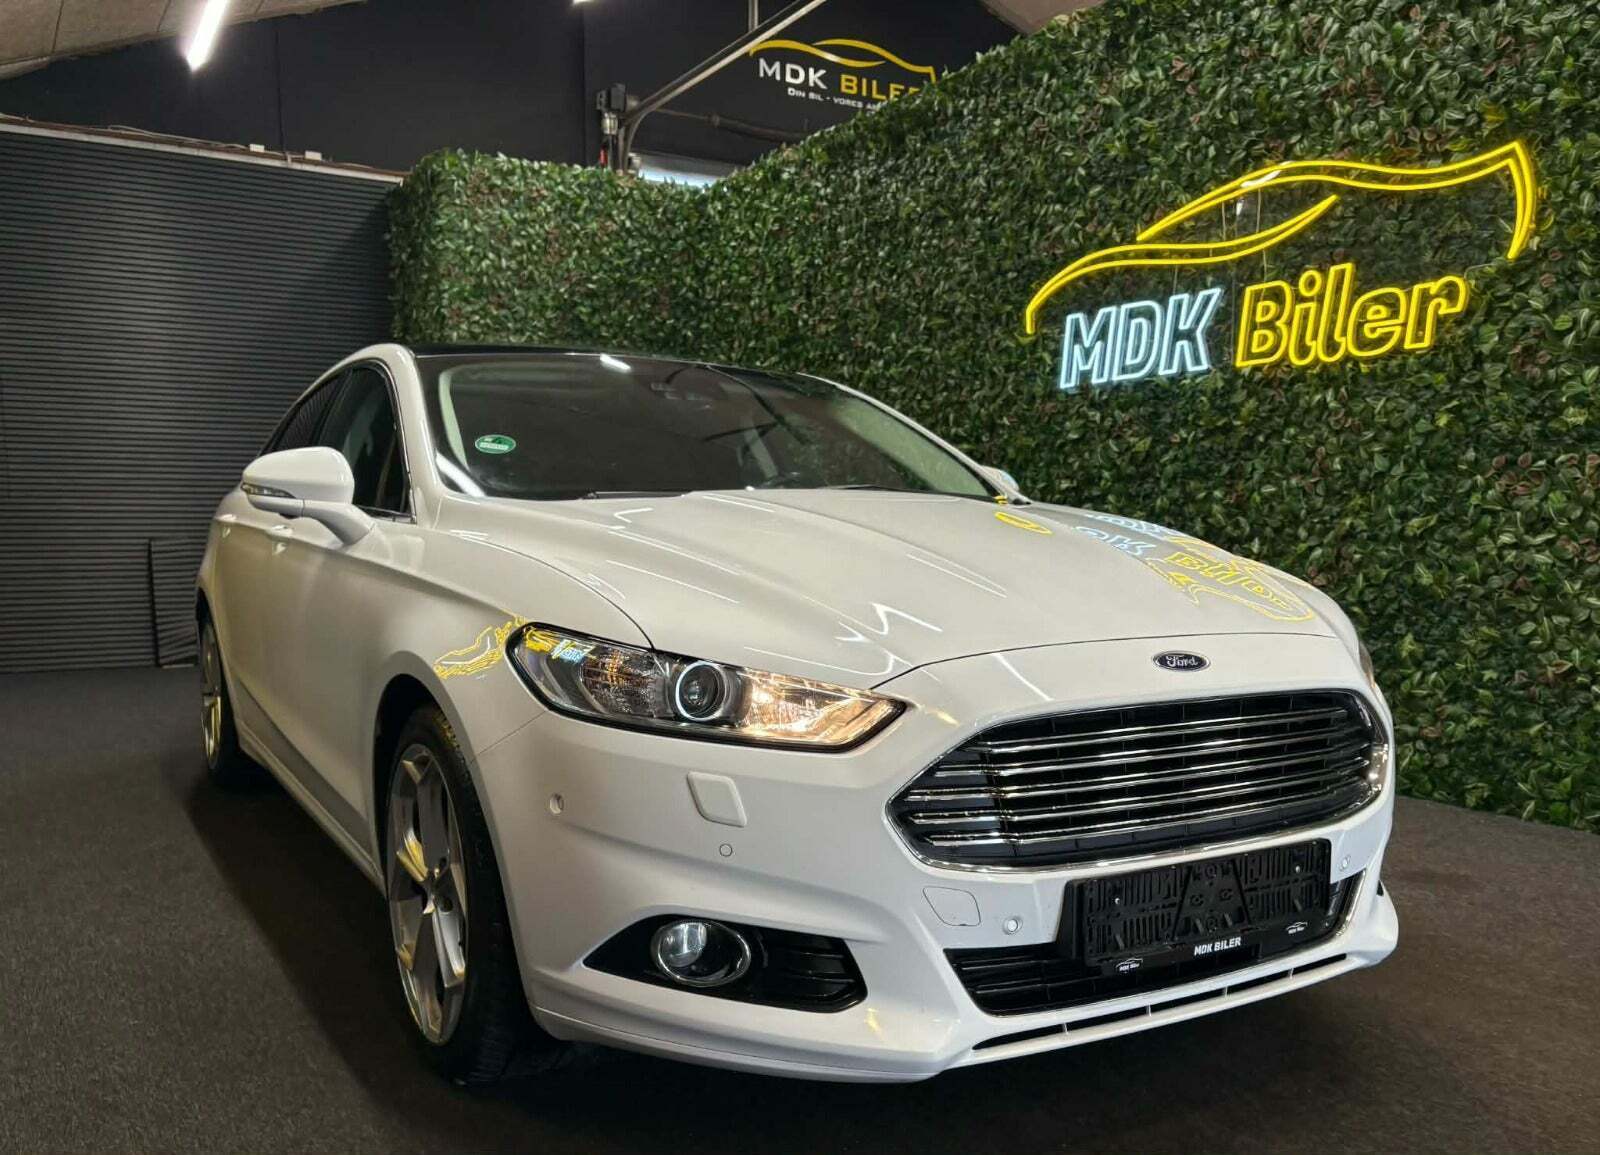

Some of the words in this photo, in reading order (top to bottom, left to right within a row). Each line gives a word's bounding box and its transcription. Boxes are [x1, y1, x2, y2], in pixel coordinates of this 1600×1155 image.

[758, 57, 828, 90] MDK
[1059, 287, 1223, 390] MDK
[1235, 262, 1468, 368] Biler
[1166, 655, 1199, 667] Ford
[1194, 943, 1213, 956] MDK
[1214, 936, 1241, 952] BILER
